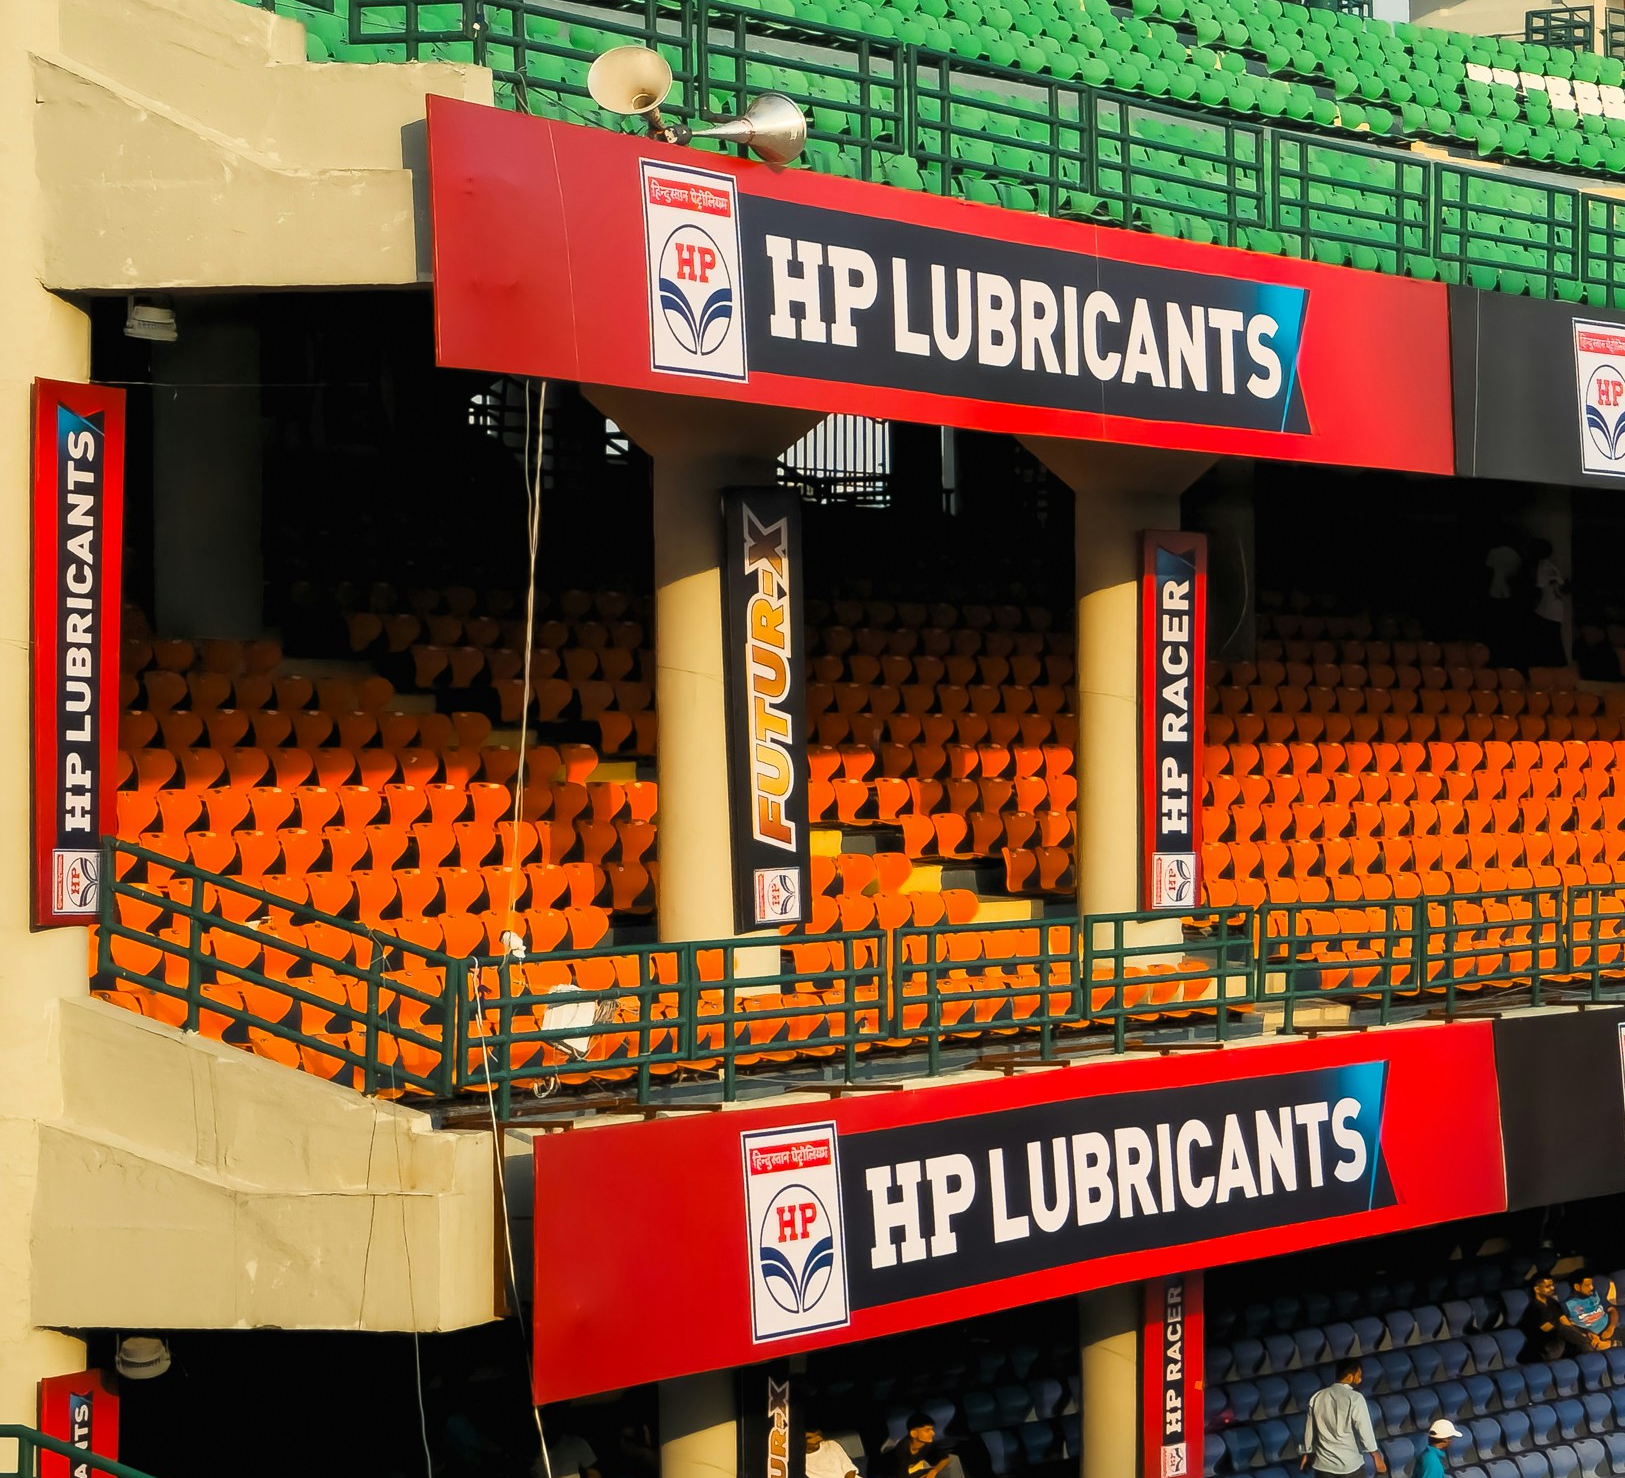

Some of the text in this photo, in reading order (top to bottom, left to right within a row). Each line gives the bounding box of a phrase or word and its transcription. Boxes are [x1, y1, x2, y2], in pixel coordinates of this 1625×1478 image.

[676, 242, 716, 285] HP
[766, 235, 1282, 400] HP LUBRICANTS
[1596, 379, 1624, 408] HP
[65, 430, 96, 832] HP LUBRICANTS
[744, 508, 794, 848] FUTUR-X
[1162, 579, 1190, 835] HP RACER
[776, 1201, 817, 1243] HP
[864, 1097, 1368, 1269] HP LUBRICANTS
[1165, 1285, 1182, 1436] HP RACER
